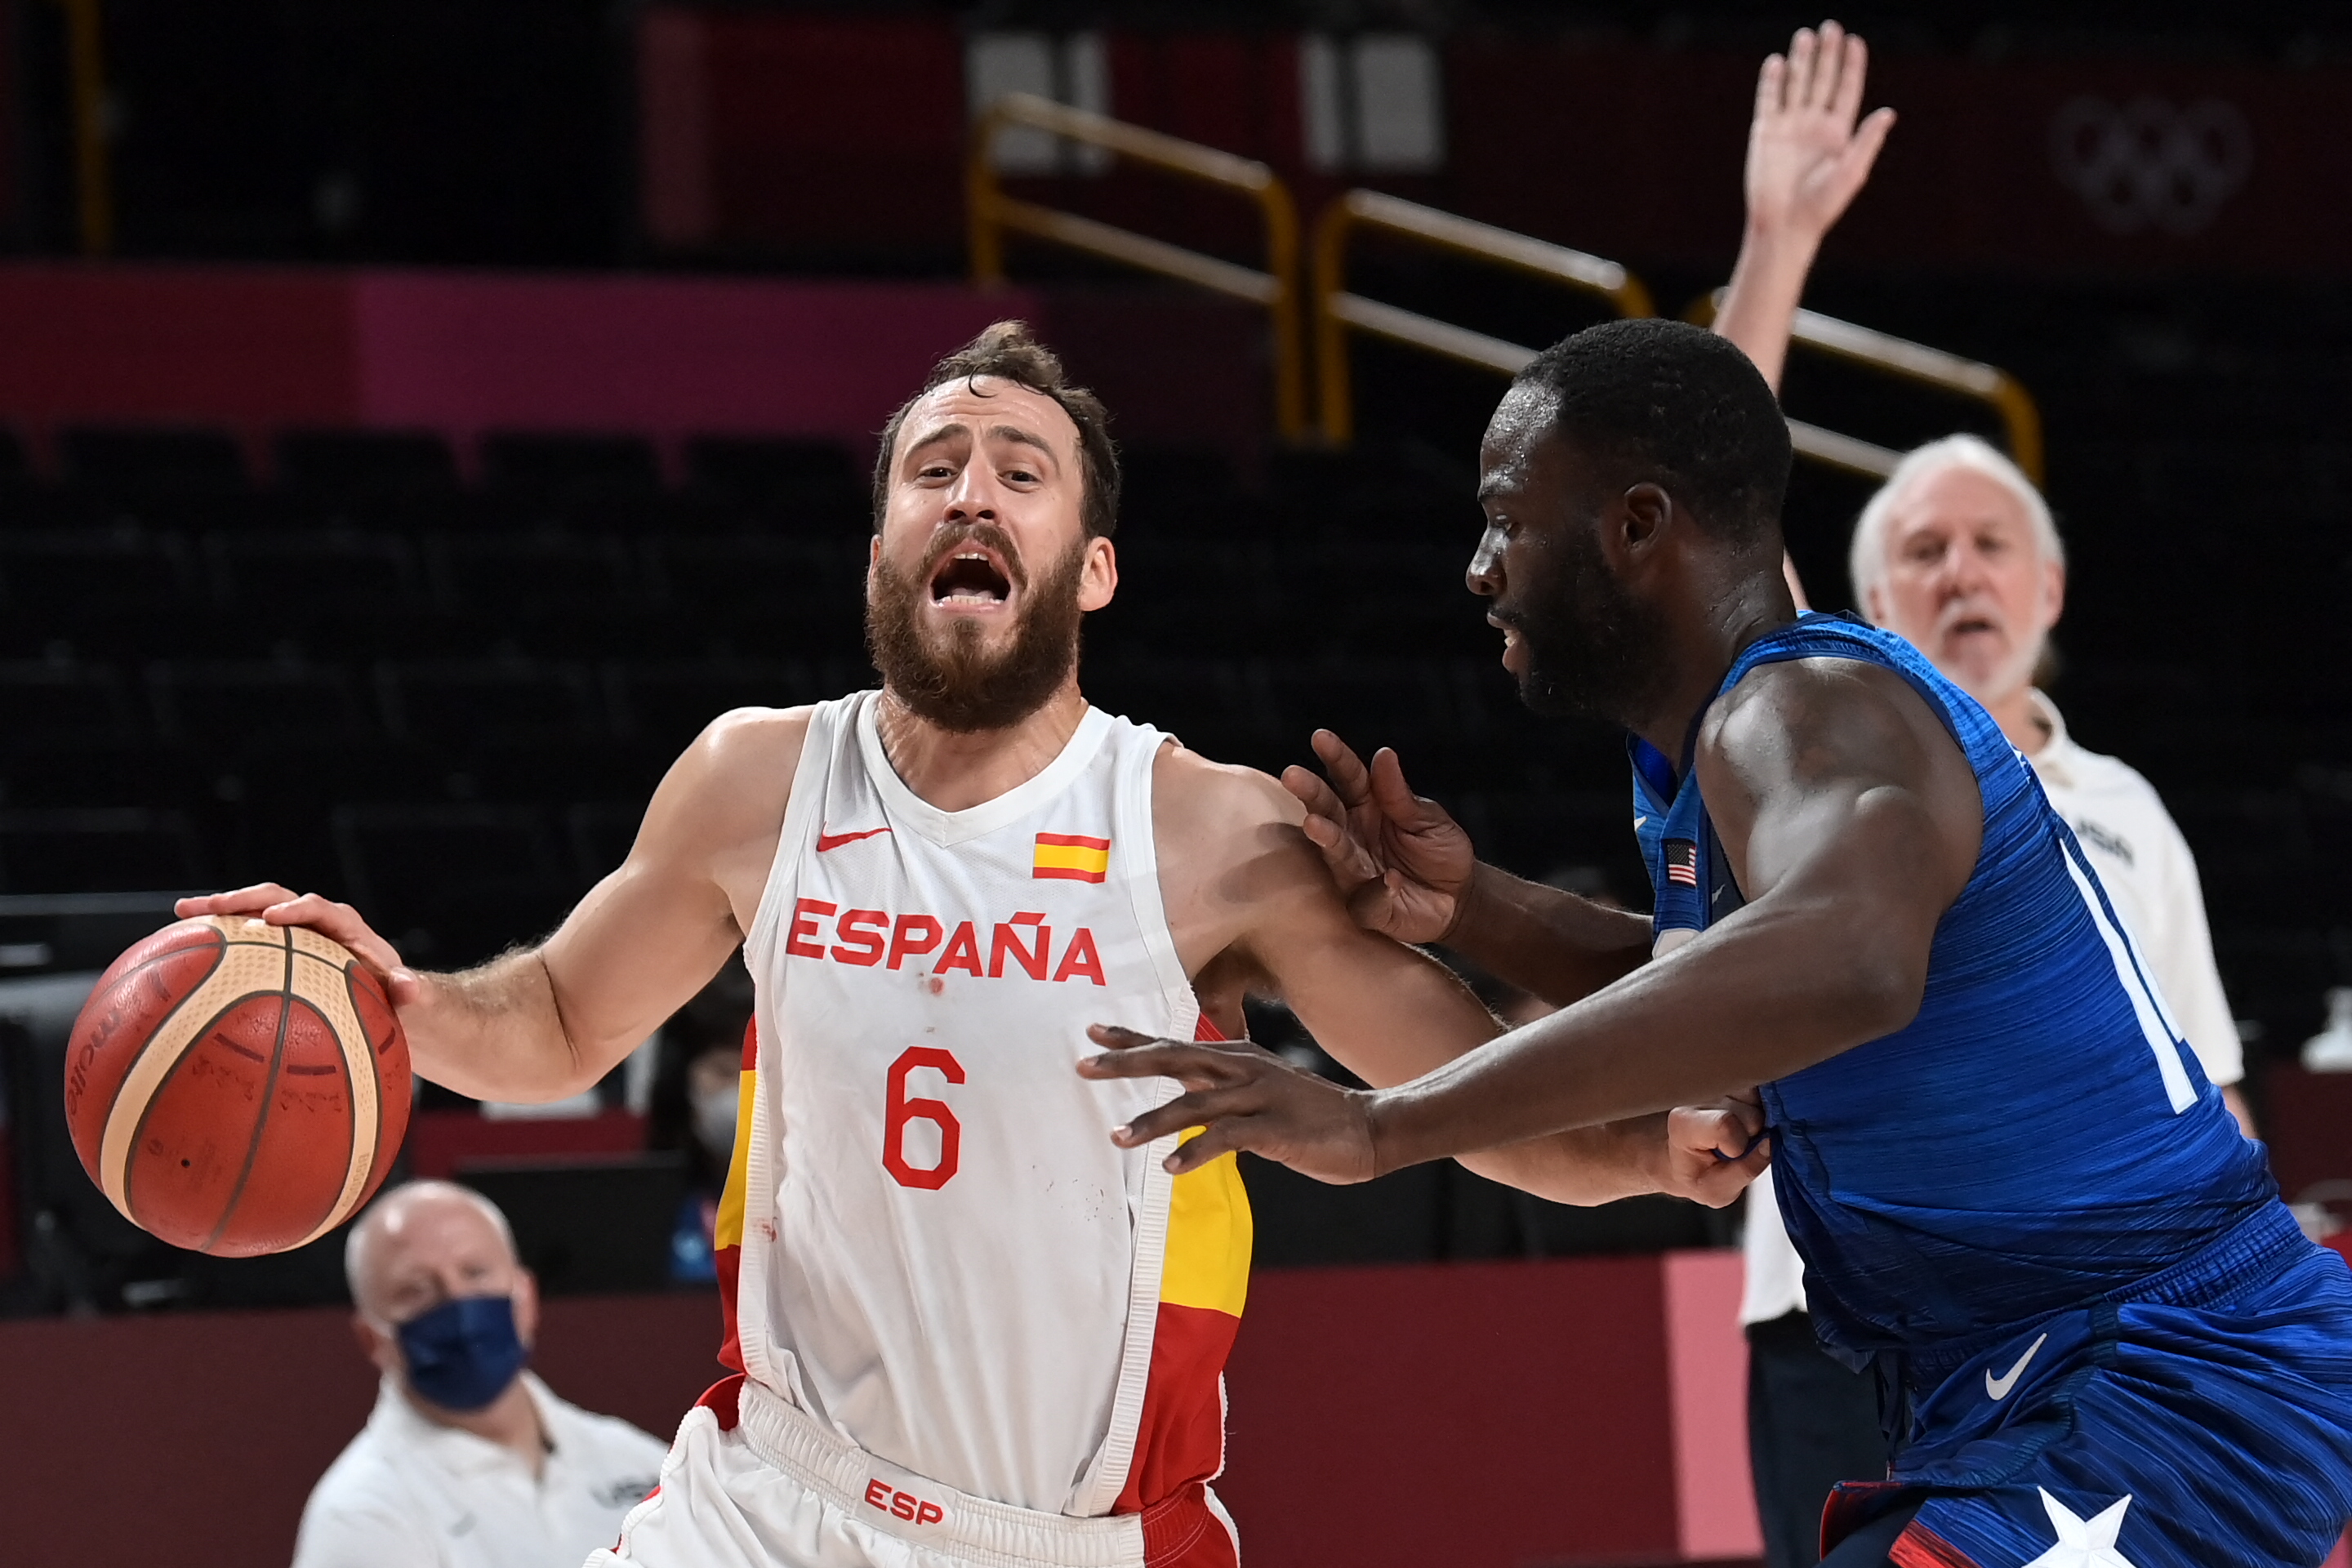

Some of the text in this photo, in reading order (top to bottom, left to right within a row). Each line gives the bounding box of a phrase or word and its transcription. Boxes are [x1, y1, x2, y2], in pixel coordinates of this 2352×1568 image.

[786, 898, 1107, 986] ESPAÑA
[883, 1045, 966, 1191] 6
[865, 1478, 944, 1526] ESP
